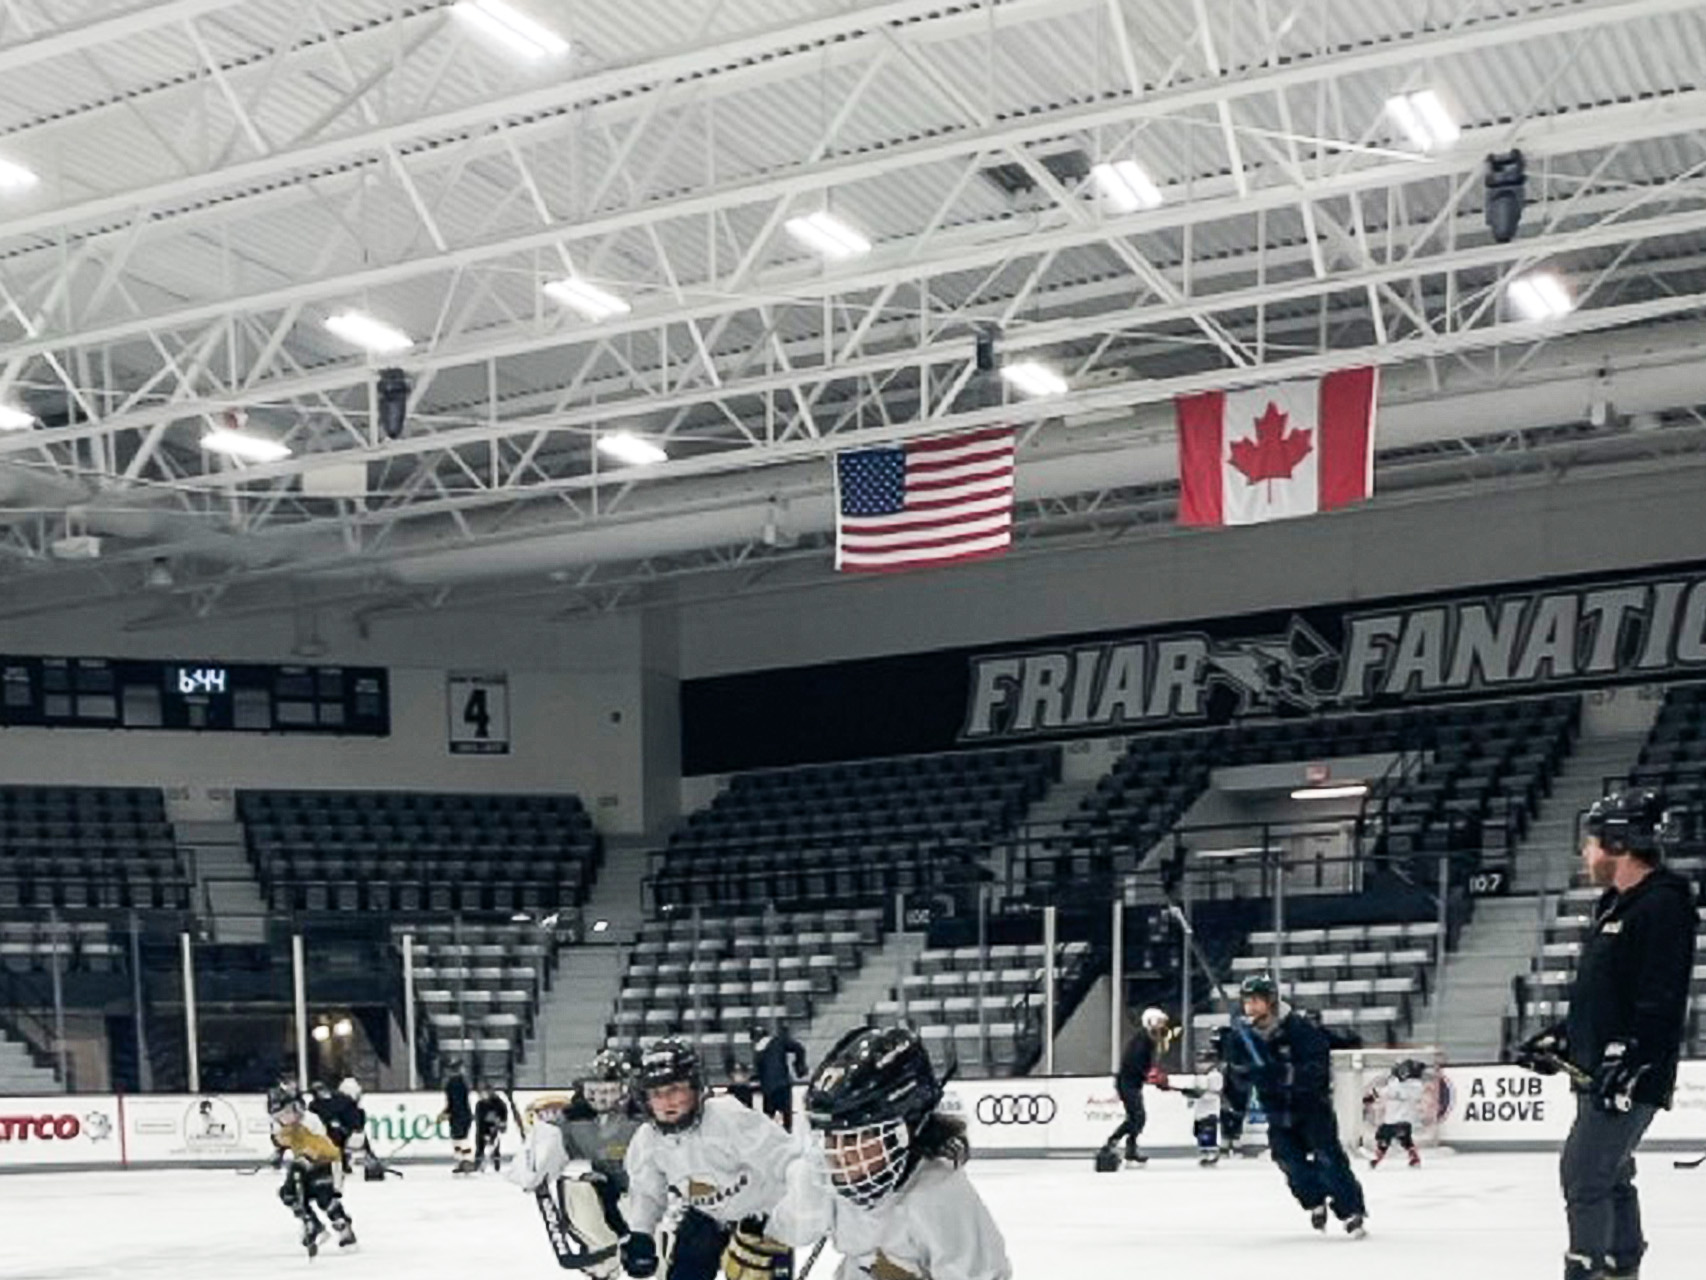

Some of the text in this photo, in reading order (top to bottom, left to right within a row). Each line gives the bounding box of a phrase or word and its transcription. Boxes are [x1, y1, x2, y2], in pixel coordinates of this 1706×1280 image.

[963, 638, 1207, 736] FRIAR
[464, 688, 490, 739] 4
[1470, 1077, 1542, 1098] A SUB
[1463, 1101, 1544, 1122] ABOVE
